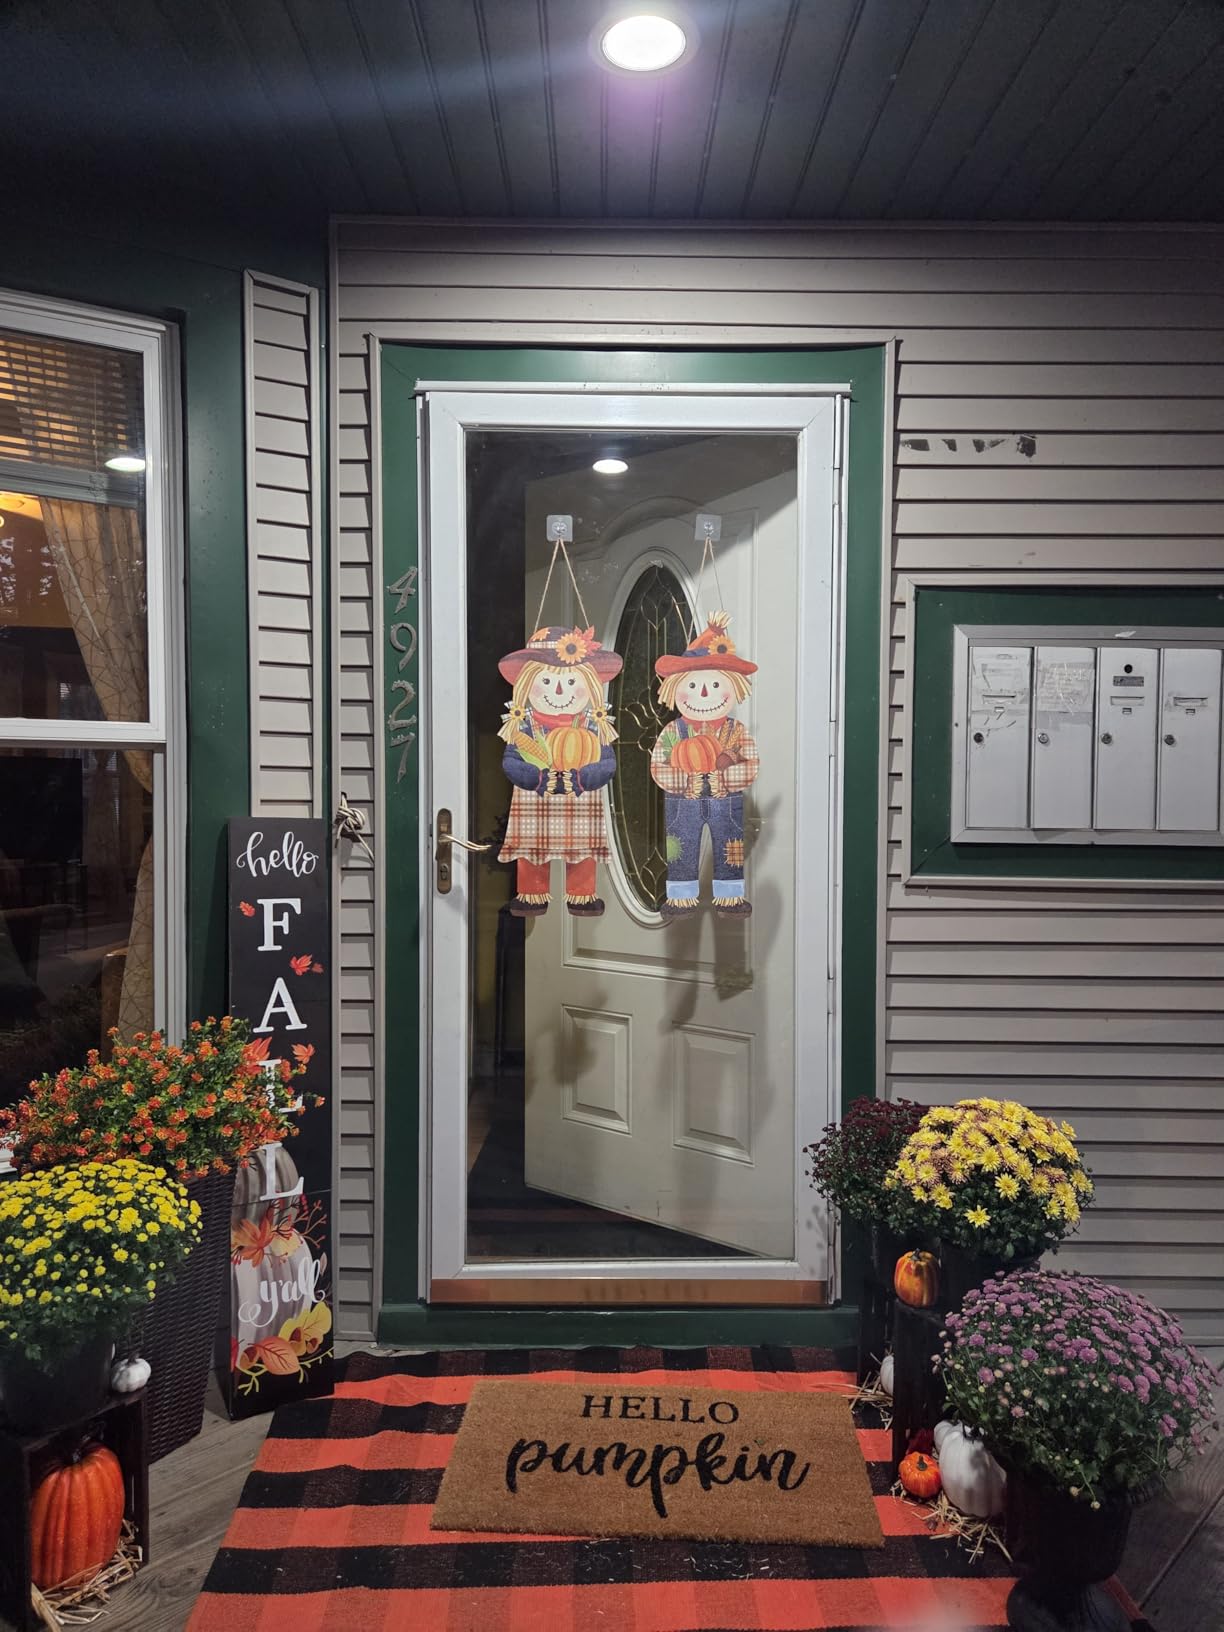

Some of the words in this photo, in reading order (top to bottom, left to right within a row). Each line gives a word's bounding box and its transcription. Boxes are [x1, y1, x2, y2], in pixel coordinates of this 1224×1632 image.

[387, 566, 417, 784] 4927
[236, 831, 319, 877] hello
[238, 1257, 326, 1328] y'all
[580, 1394, 740, 1425] HELLO
[506, 1432, 809, 1518] pumpkin
